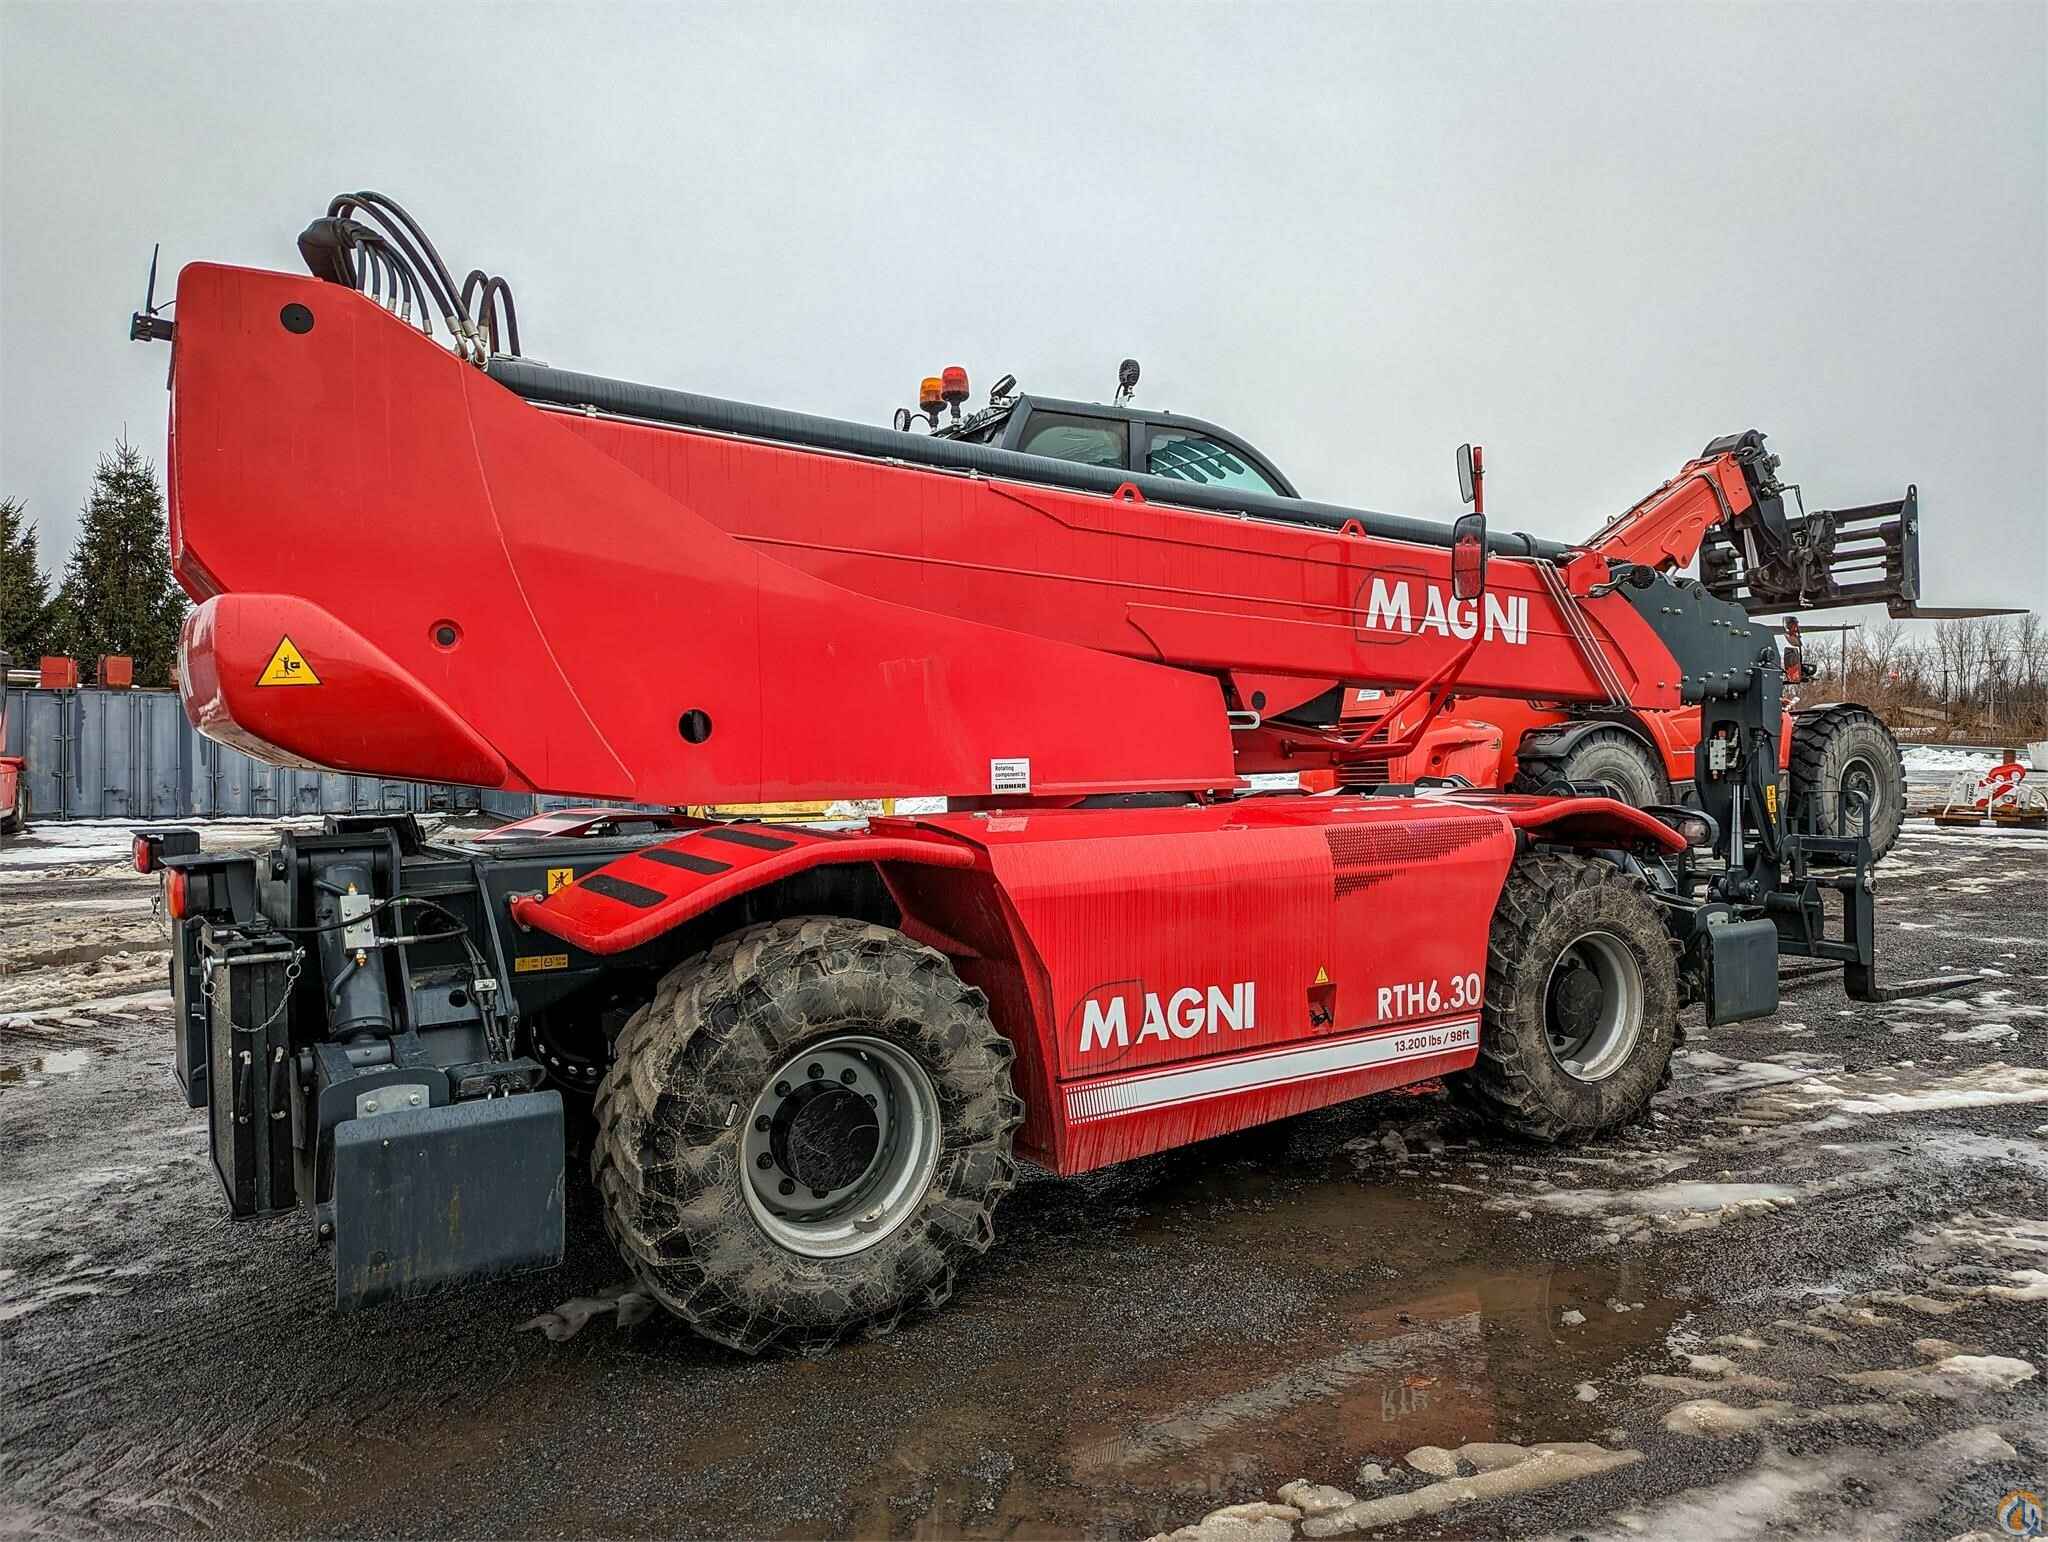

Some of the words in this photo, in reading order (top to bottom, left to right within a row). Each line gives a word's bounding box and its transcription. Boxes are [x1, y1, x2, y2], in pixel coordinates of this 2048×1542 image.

[1366, 577, 1529, 645] MAGNI
[1080, 981, 1255, 1052] MAGNI
[1378, 973, 1481, 1020] RTH6.30
[1395, 1036, 1427, 1053] 13.200
[1428, 1035, 1442, 1047] lbs
[1450, 1028, 1470, 1042] 98ft
